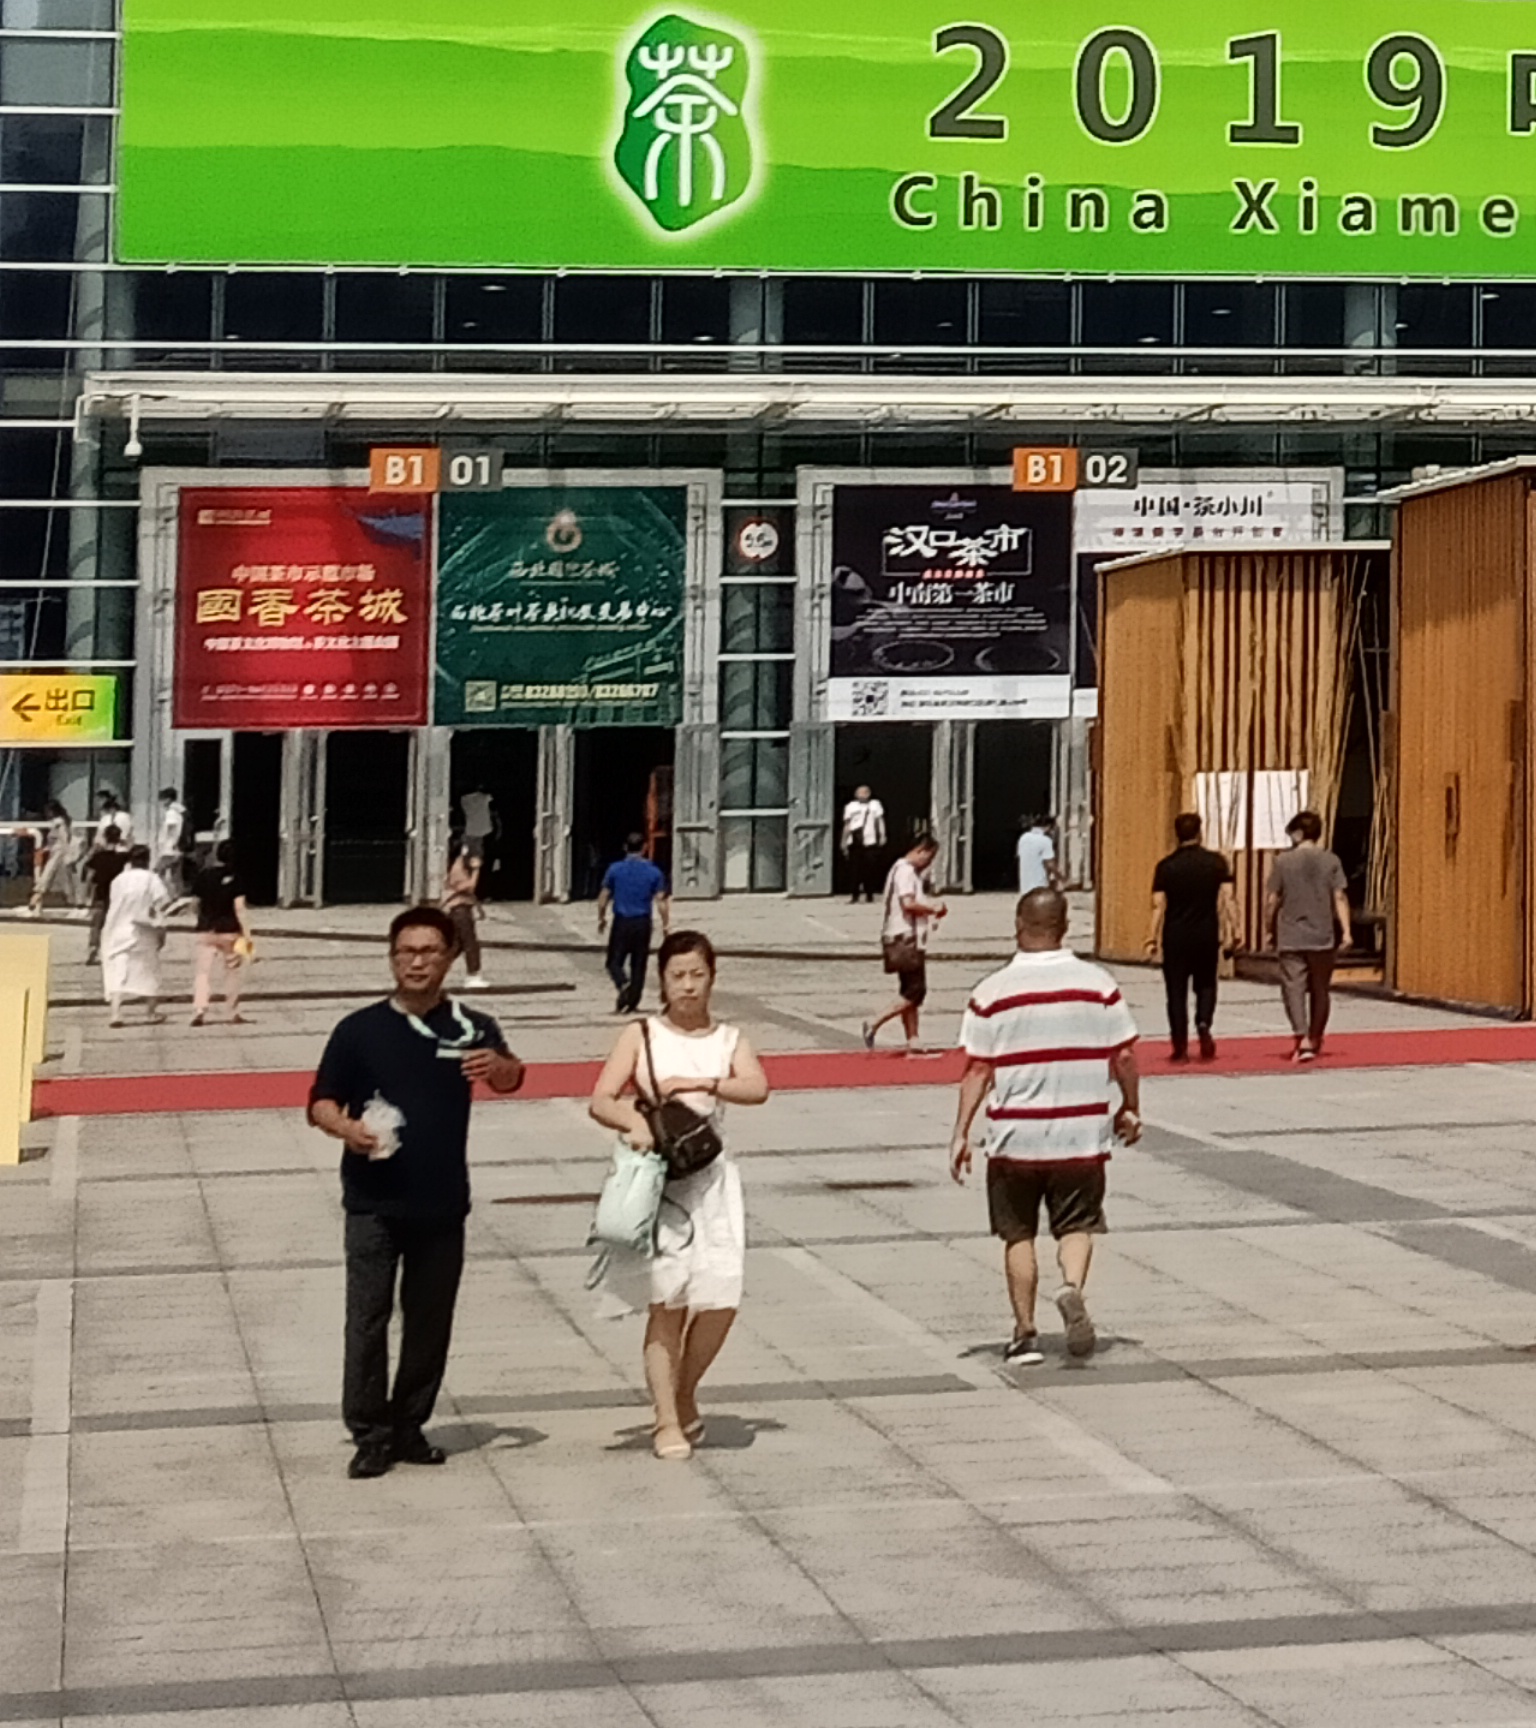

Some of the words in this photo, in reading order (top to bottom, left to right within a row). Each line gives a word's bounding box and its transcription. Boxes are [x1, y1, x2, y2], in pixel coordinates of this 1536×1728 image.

[893, 174, 1166, 231] China
[385, 454, 423, 486] B1
[449, 454, 490, 486] 01
[1026, 454, 1062, 485] B1
[1085, 454, 1129, 485] 02
[883, 523, 1029, 567] 汉口茶市
[196, 587, 409, 627] 國香茶城
[45, 688, 95, 712] 出口
